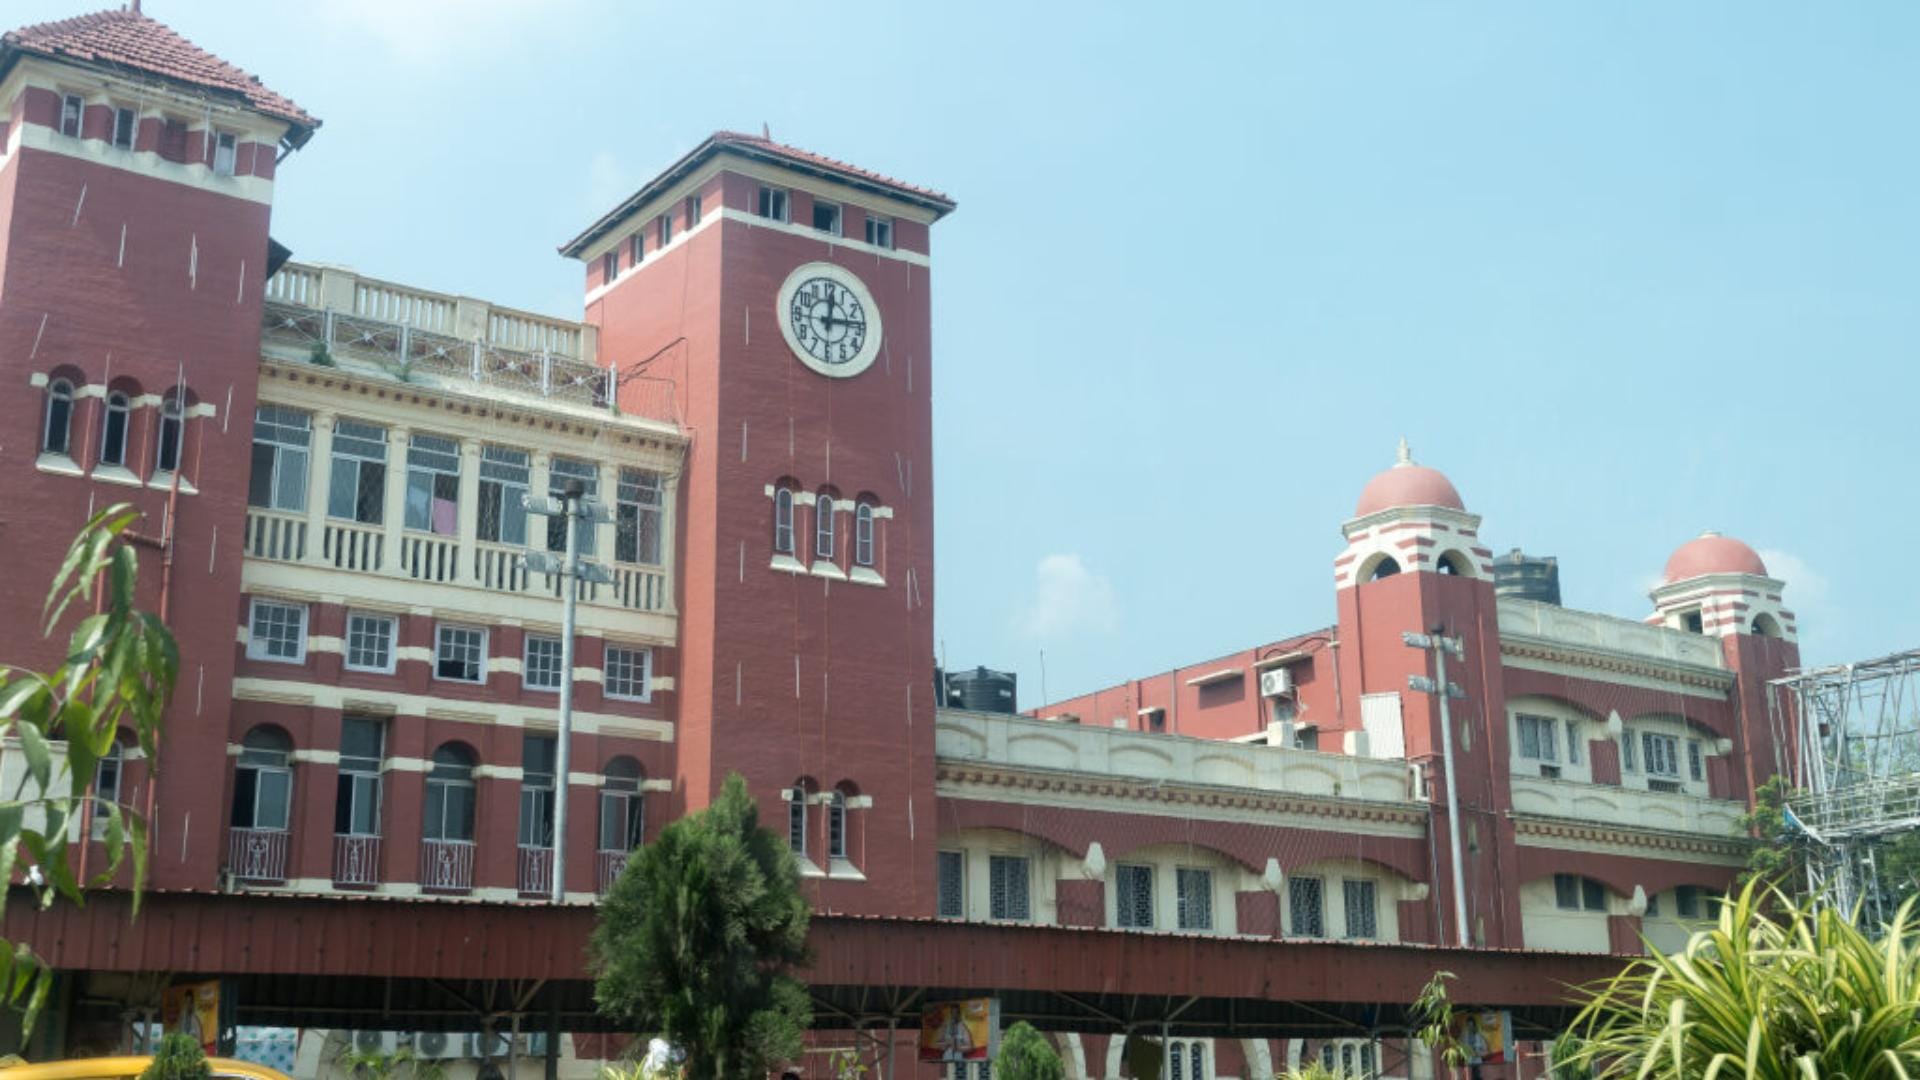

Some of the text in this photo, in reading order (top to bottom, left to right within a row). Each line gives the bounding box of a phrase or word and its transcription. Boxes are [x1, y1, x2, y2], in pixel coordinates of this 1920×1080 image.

[800, 291, 811, 307] 10
[794, 306, 801, 322] 9
[850, 304, 858, 318] 2
[800, 324, 807, 340] 8
[811, 338, 818, 354] 7
[850, 338, 860, 353] 4
